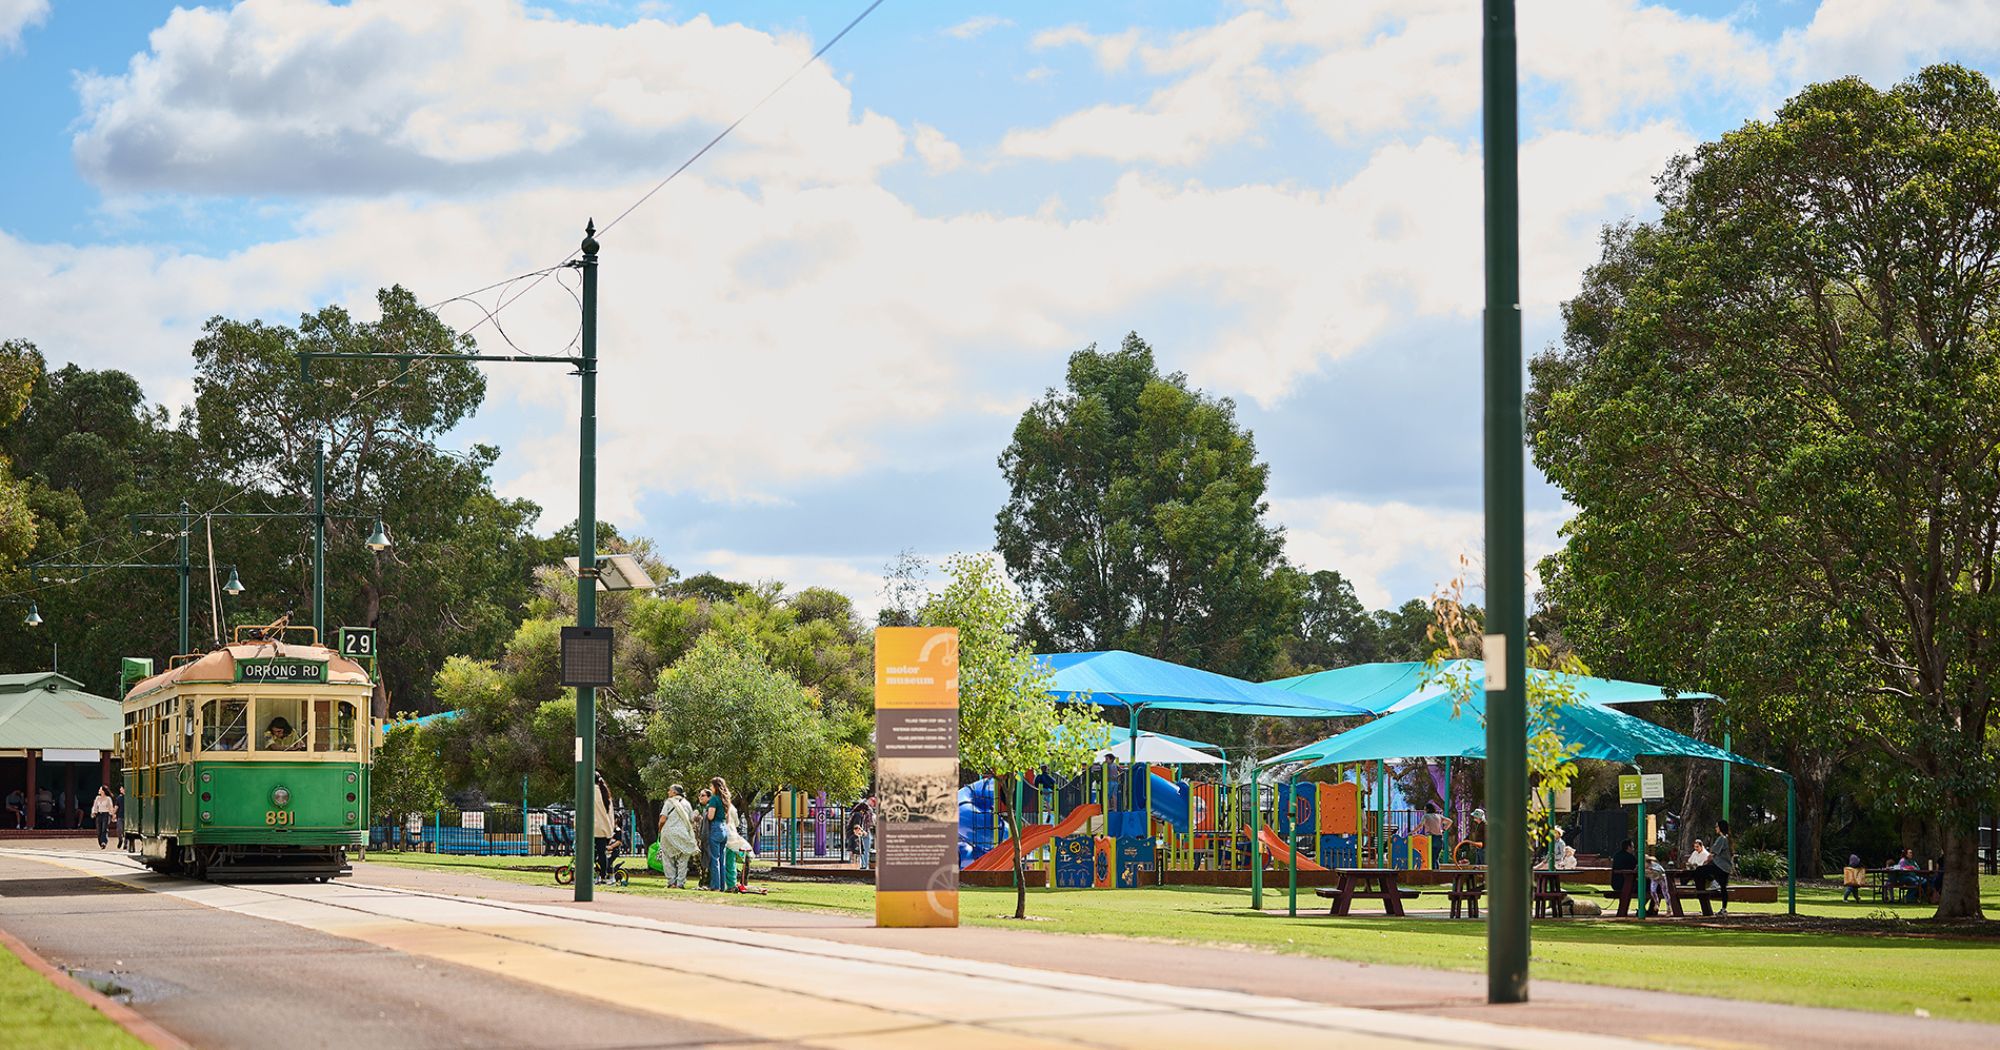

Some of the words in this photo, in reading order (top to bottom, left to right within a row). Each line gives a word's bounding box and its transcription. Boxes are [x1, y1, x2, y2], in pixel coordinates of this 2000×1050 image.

[346, 634, 371, 654] 29
[245, 665, 297, 677] ORRONG
[303, 665, 319, 677] RD
[886, 665, 920, 674] motor
[886, 677, 934, 685] museum
[1623, 783, 1637, 791] PP
[265, 810, 295, 825] 891
